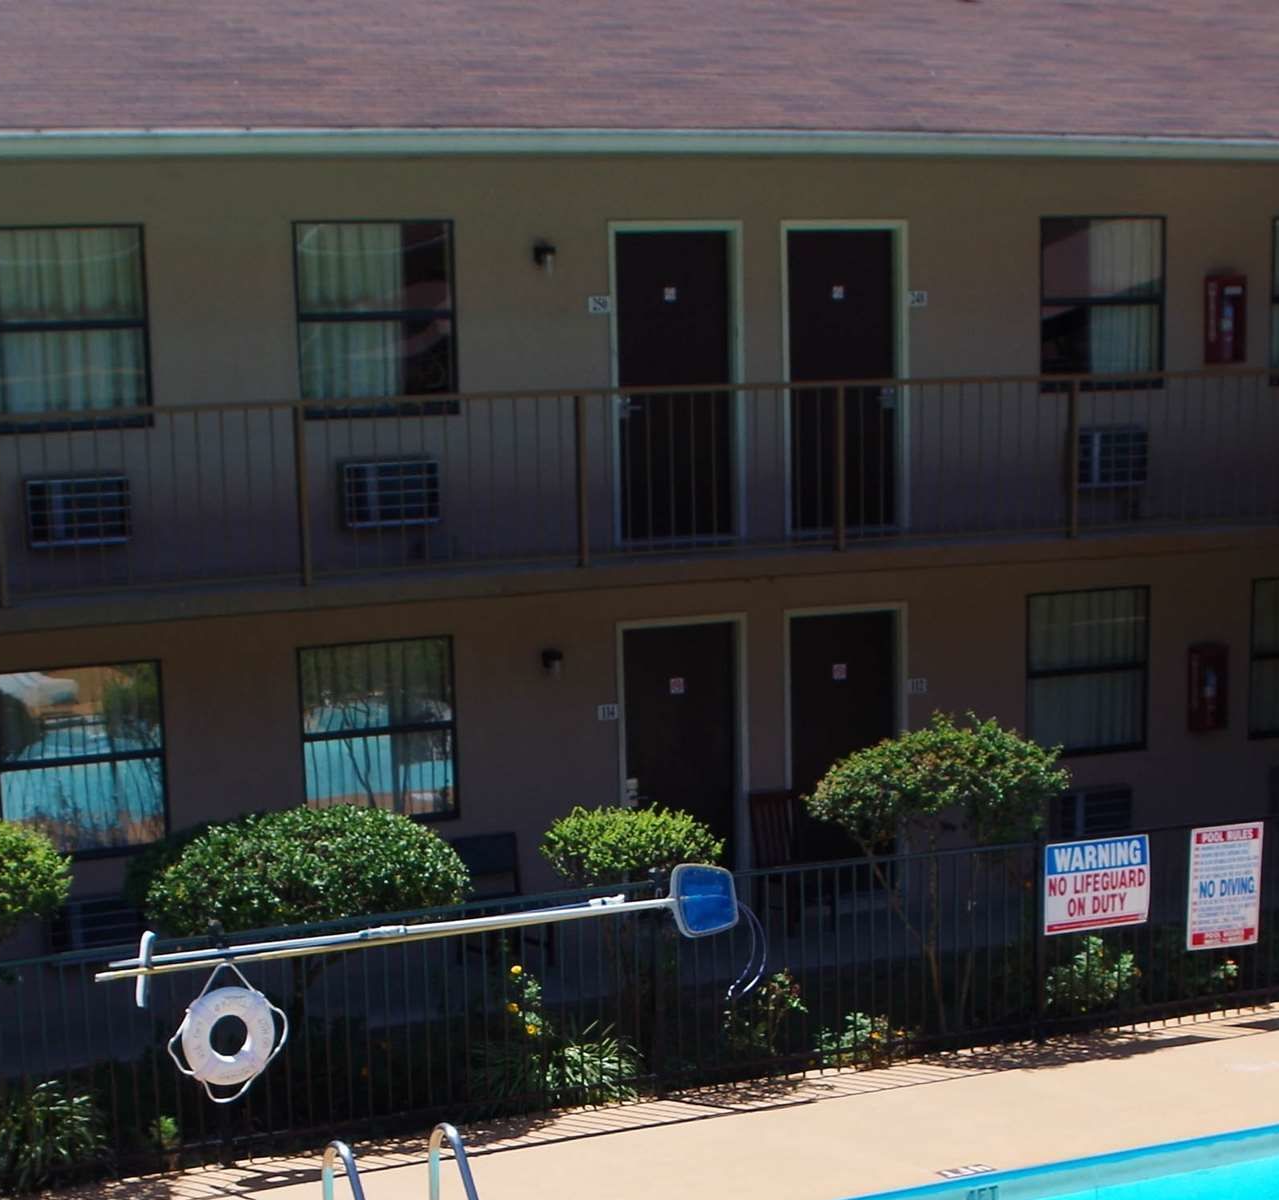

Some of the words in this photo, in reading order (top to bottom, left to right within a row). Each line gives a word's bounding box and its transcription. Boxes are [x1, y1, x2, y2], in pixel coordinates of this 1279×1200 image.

[1201, 831, 1225, 843] POOL
[1227, 828, 1253, 841] RULES
[1053, 839, 1142, 872] WARNING
[1048, 877, 1067, 896] NO
[1074, 868, 1146, 894] LIFEGUARD
[1199, 880, 1216, 898] NO
[1220, 876, 1255, 896] DIVING
[1067, 897, 1086, 917] ON
[1092, 892, 1127, 914] DUTY
